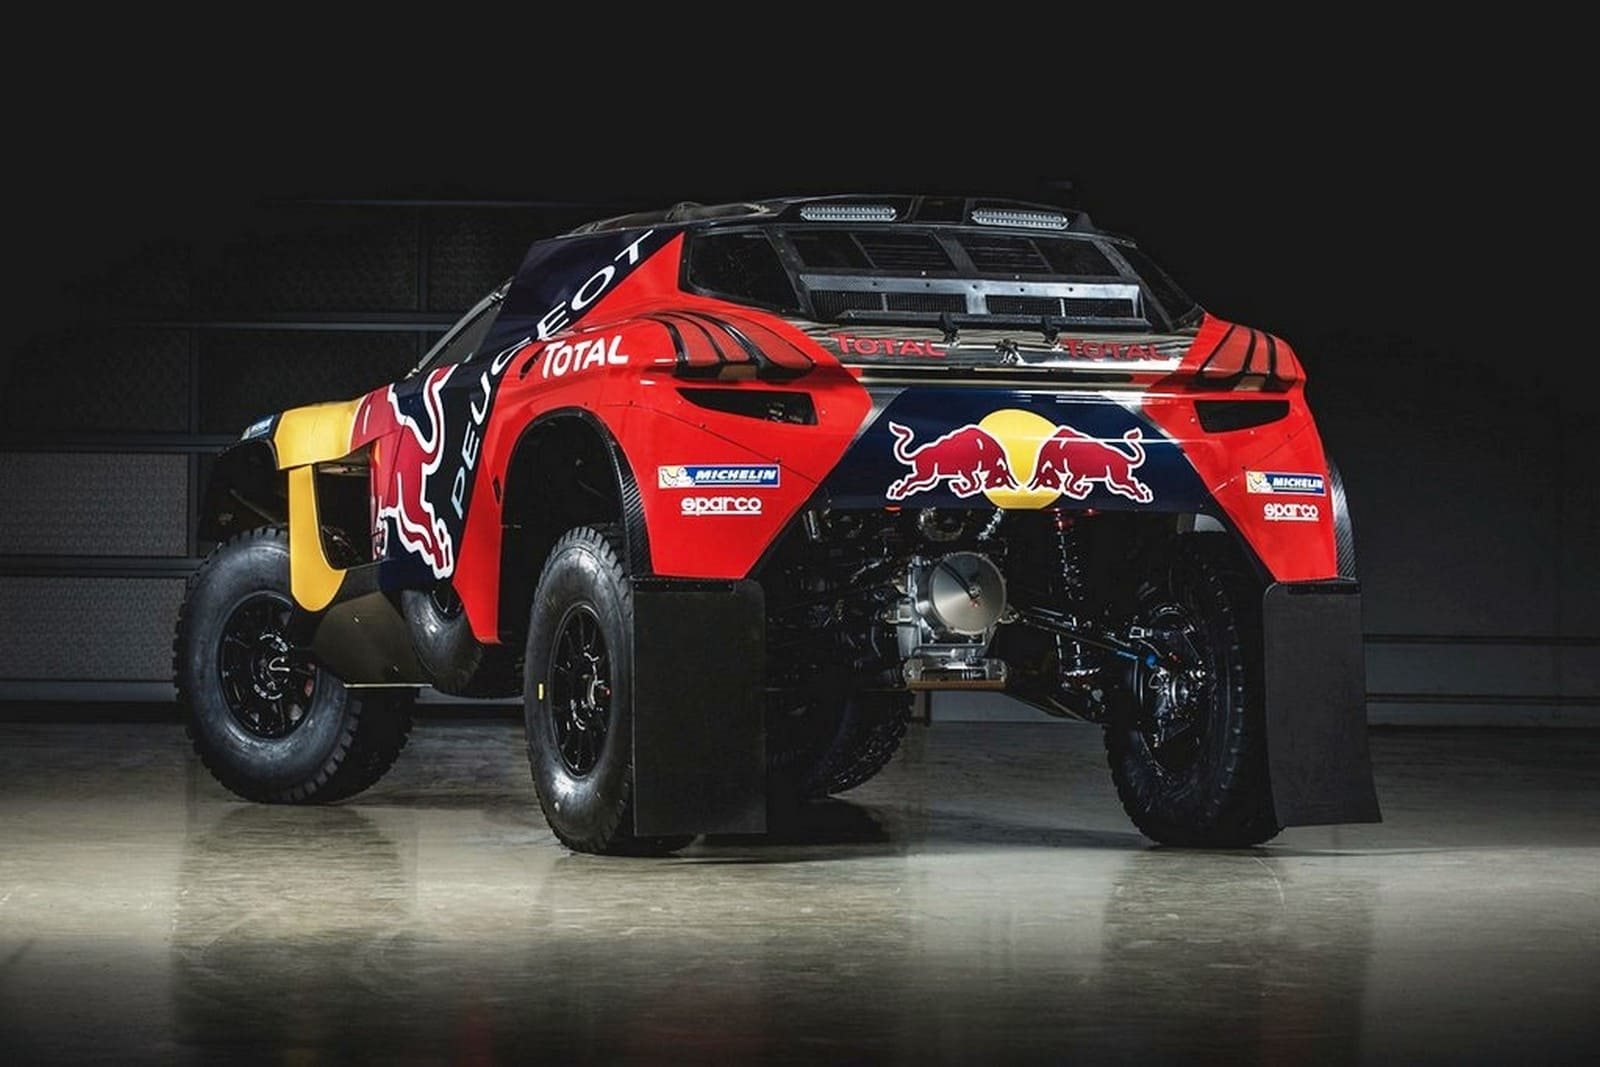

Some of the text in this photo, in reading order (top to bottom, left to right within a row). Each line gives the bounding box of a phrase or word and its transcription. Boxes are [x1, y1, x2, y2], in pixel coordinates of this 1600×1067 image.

[829, 331, 946, 357] TOTAL
[1060, 339, 1169, 361] TOTAL
[541, 335, 629, 379] TOTAL
[694, 469, 777, 481] MICHELIN
[1272, 477, 1324, 488] MICHELIN
[681, 496, 762, 516] sparco
